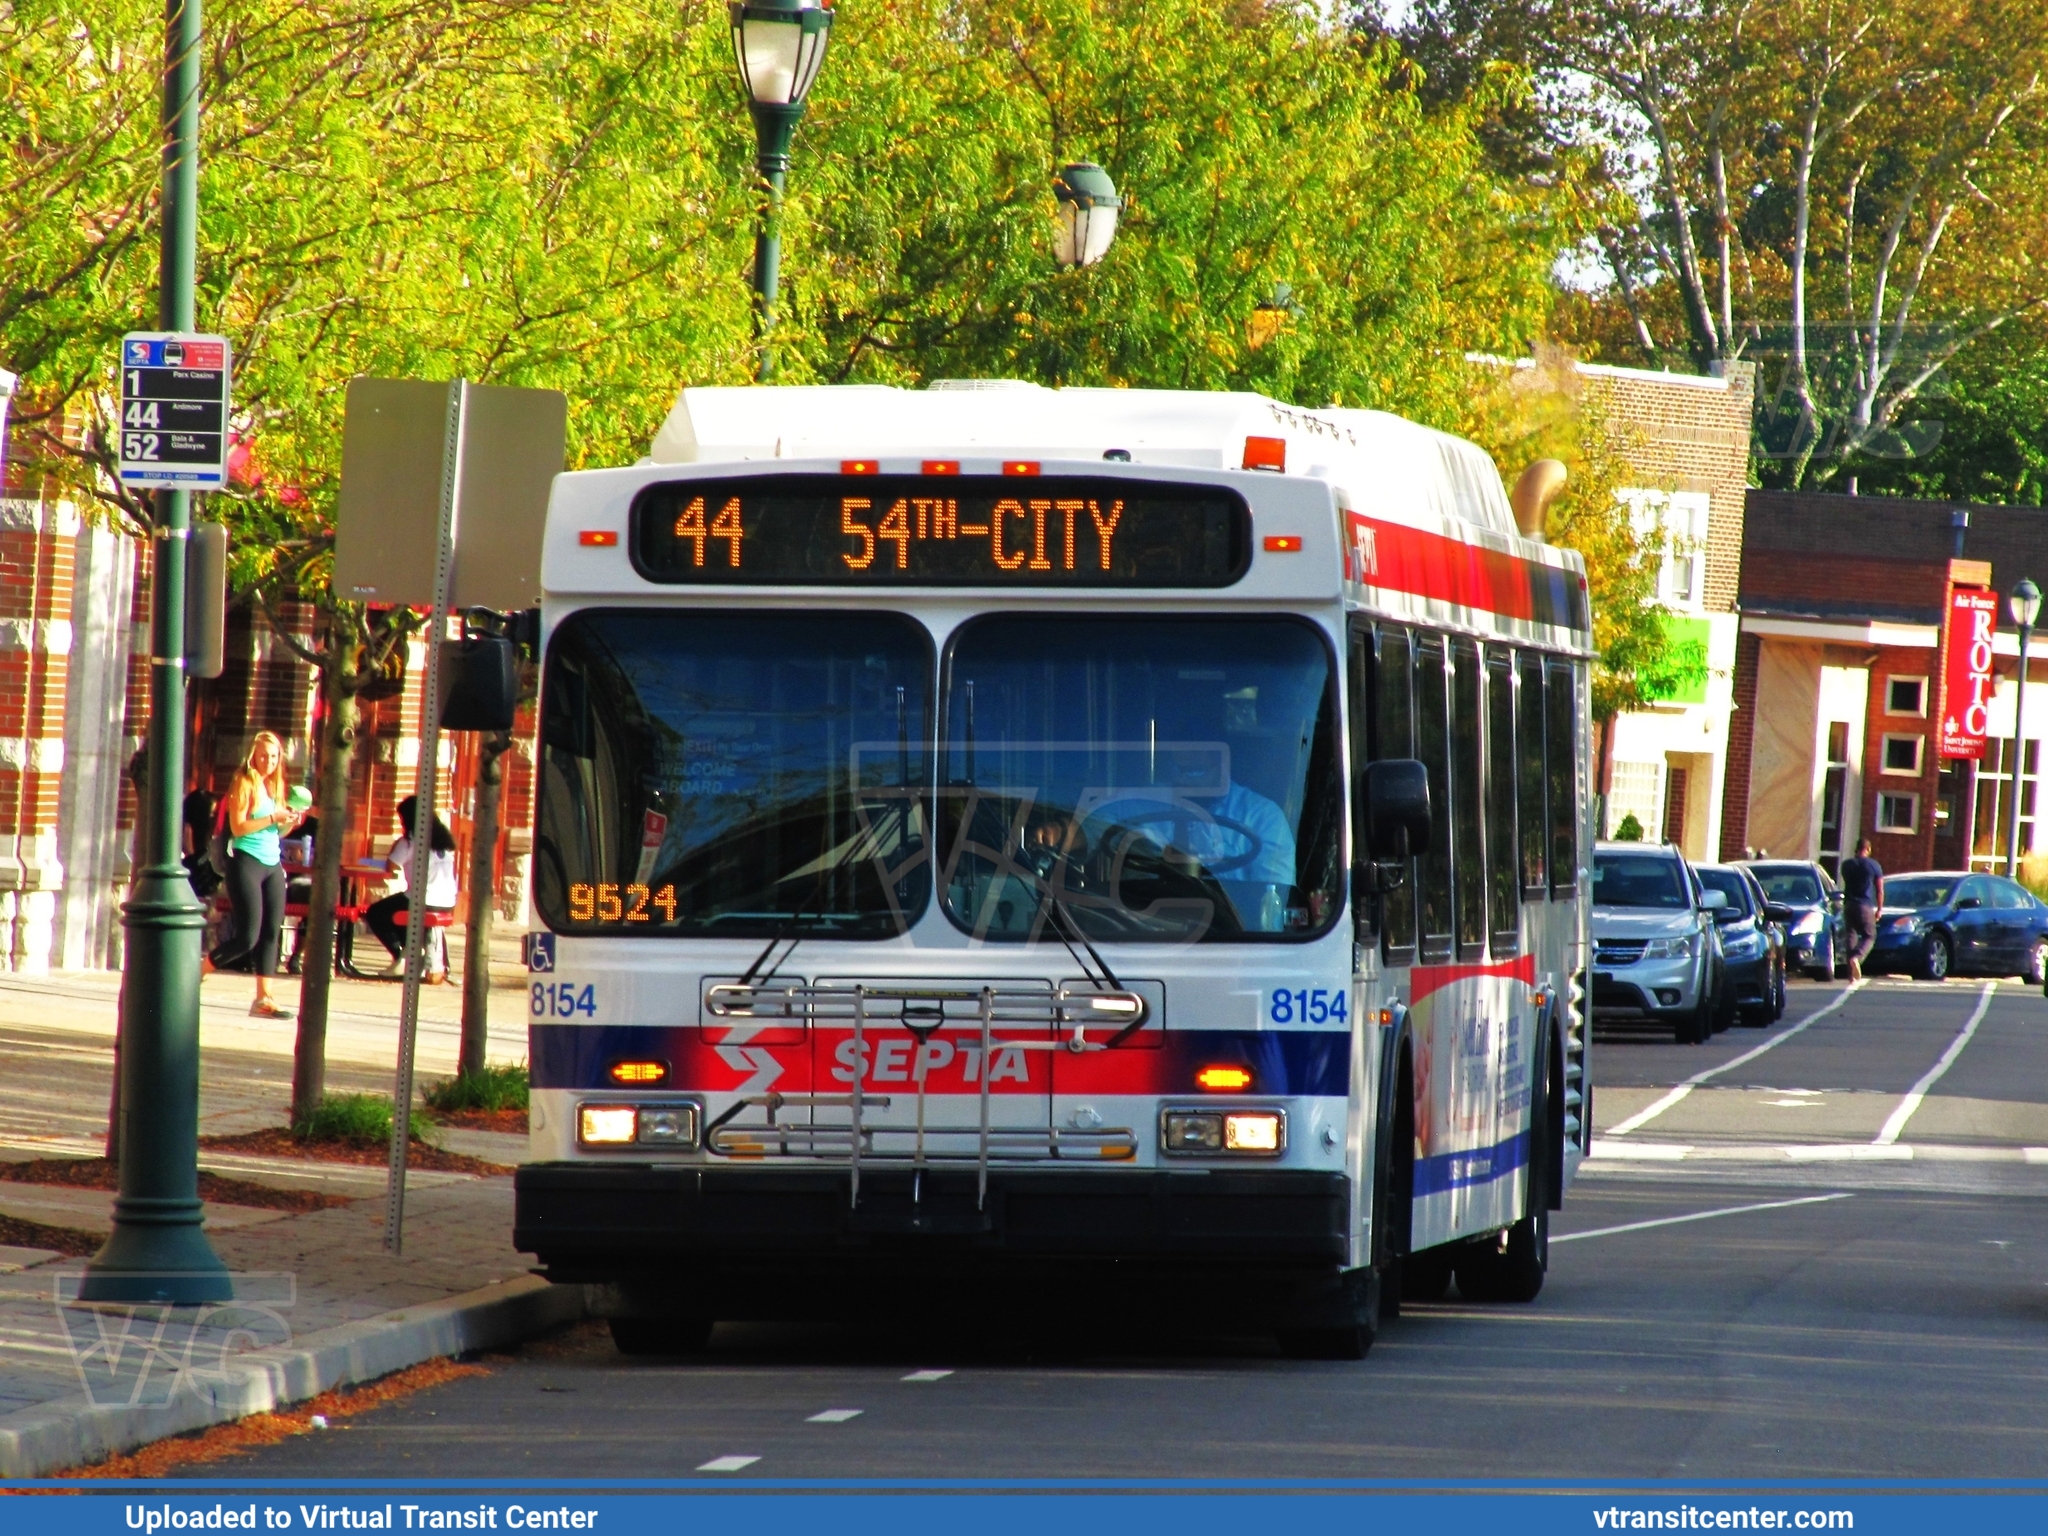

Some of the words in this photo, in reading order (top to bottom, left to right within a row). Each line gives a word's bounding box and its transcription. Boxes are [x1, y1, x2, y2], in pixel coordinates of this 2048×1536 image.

[127, 358, 150, 366] SEPTA
[173, 370, 190, 379] Parx
[190, 371, 215, 380] Casino
[127, 369, 140, 396] 1
[125, 401, 160, 428] 44
[172, 403, 203, 411] Ardmore
[125, 433, 160, 460] 52
[171, 442, 206, 451] Gladwyne
[674, 497, 744, 567] 44
[1955, 594, 1970, 607] Air
[1971, 595, 1996, 609] Force
[1967, 610, 1992, 735] ROTC
[570, 882, 678, 921] 9524
[530, 982, 597, 1018] 8154
[1271, 988, 1348, 1024] 8154
[831, 1038, 1030, 1084] SEPTA
